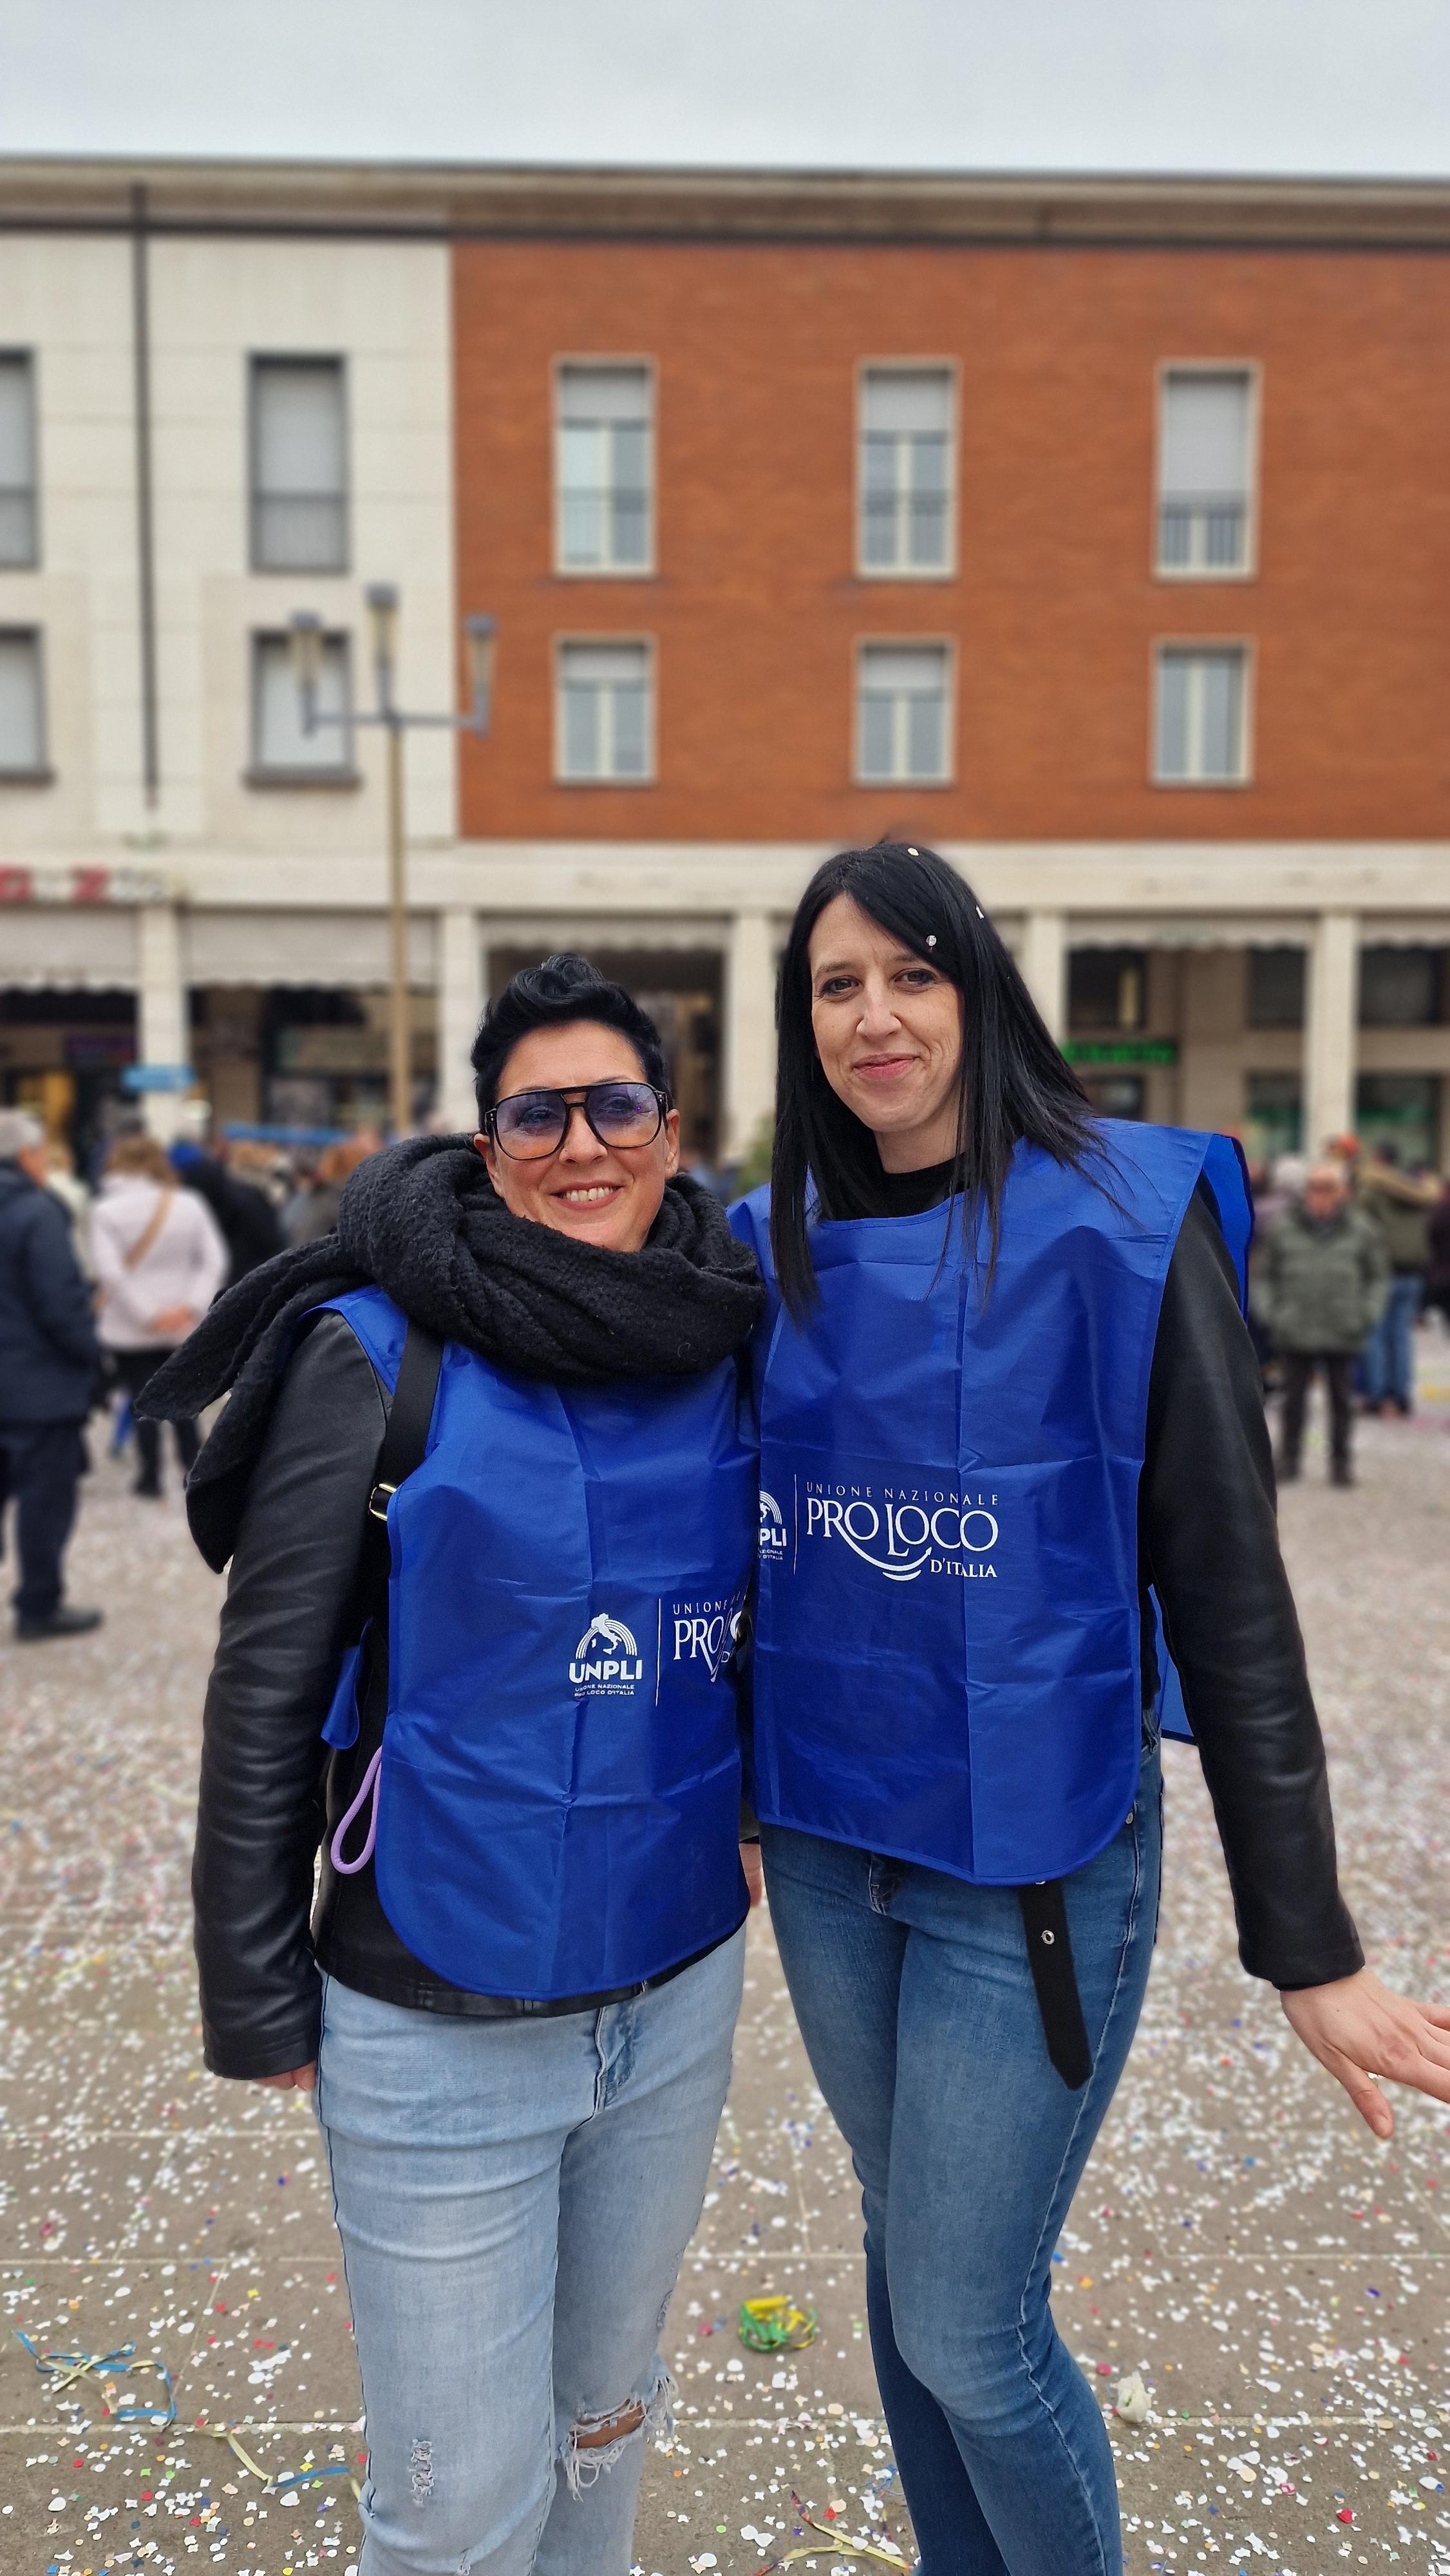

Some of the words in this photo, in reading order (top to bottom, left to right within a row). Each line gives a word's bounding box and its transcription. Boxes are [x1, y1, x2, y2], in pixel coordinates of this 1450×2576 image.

[806, 1481, 872, 1497] UNIONE
[884, 1488, 999, 1505] NAZIONALE
[758, 1528, 787, 1546] PLI
[930, 1557, 997, 1578] D'ITALIA
[673, 1600, 728, 1615] UNIONE
[569, 1659, 643, 1683] UNPLI
